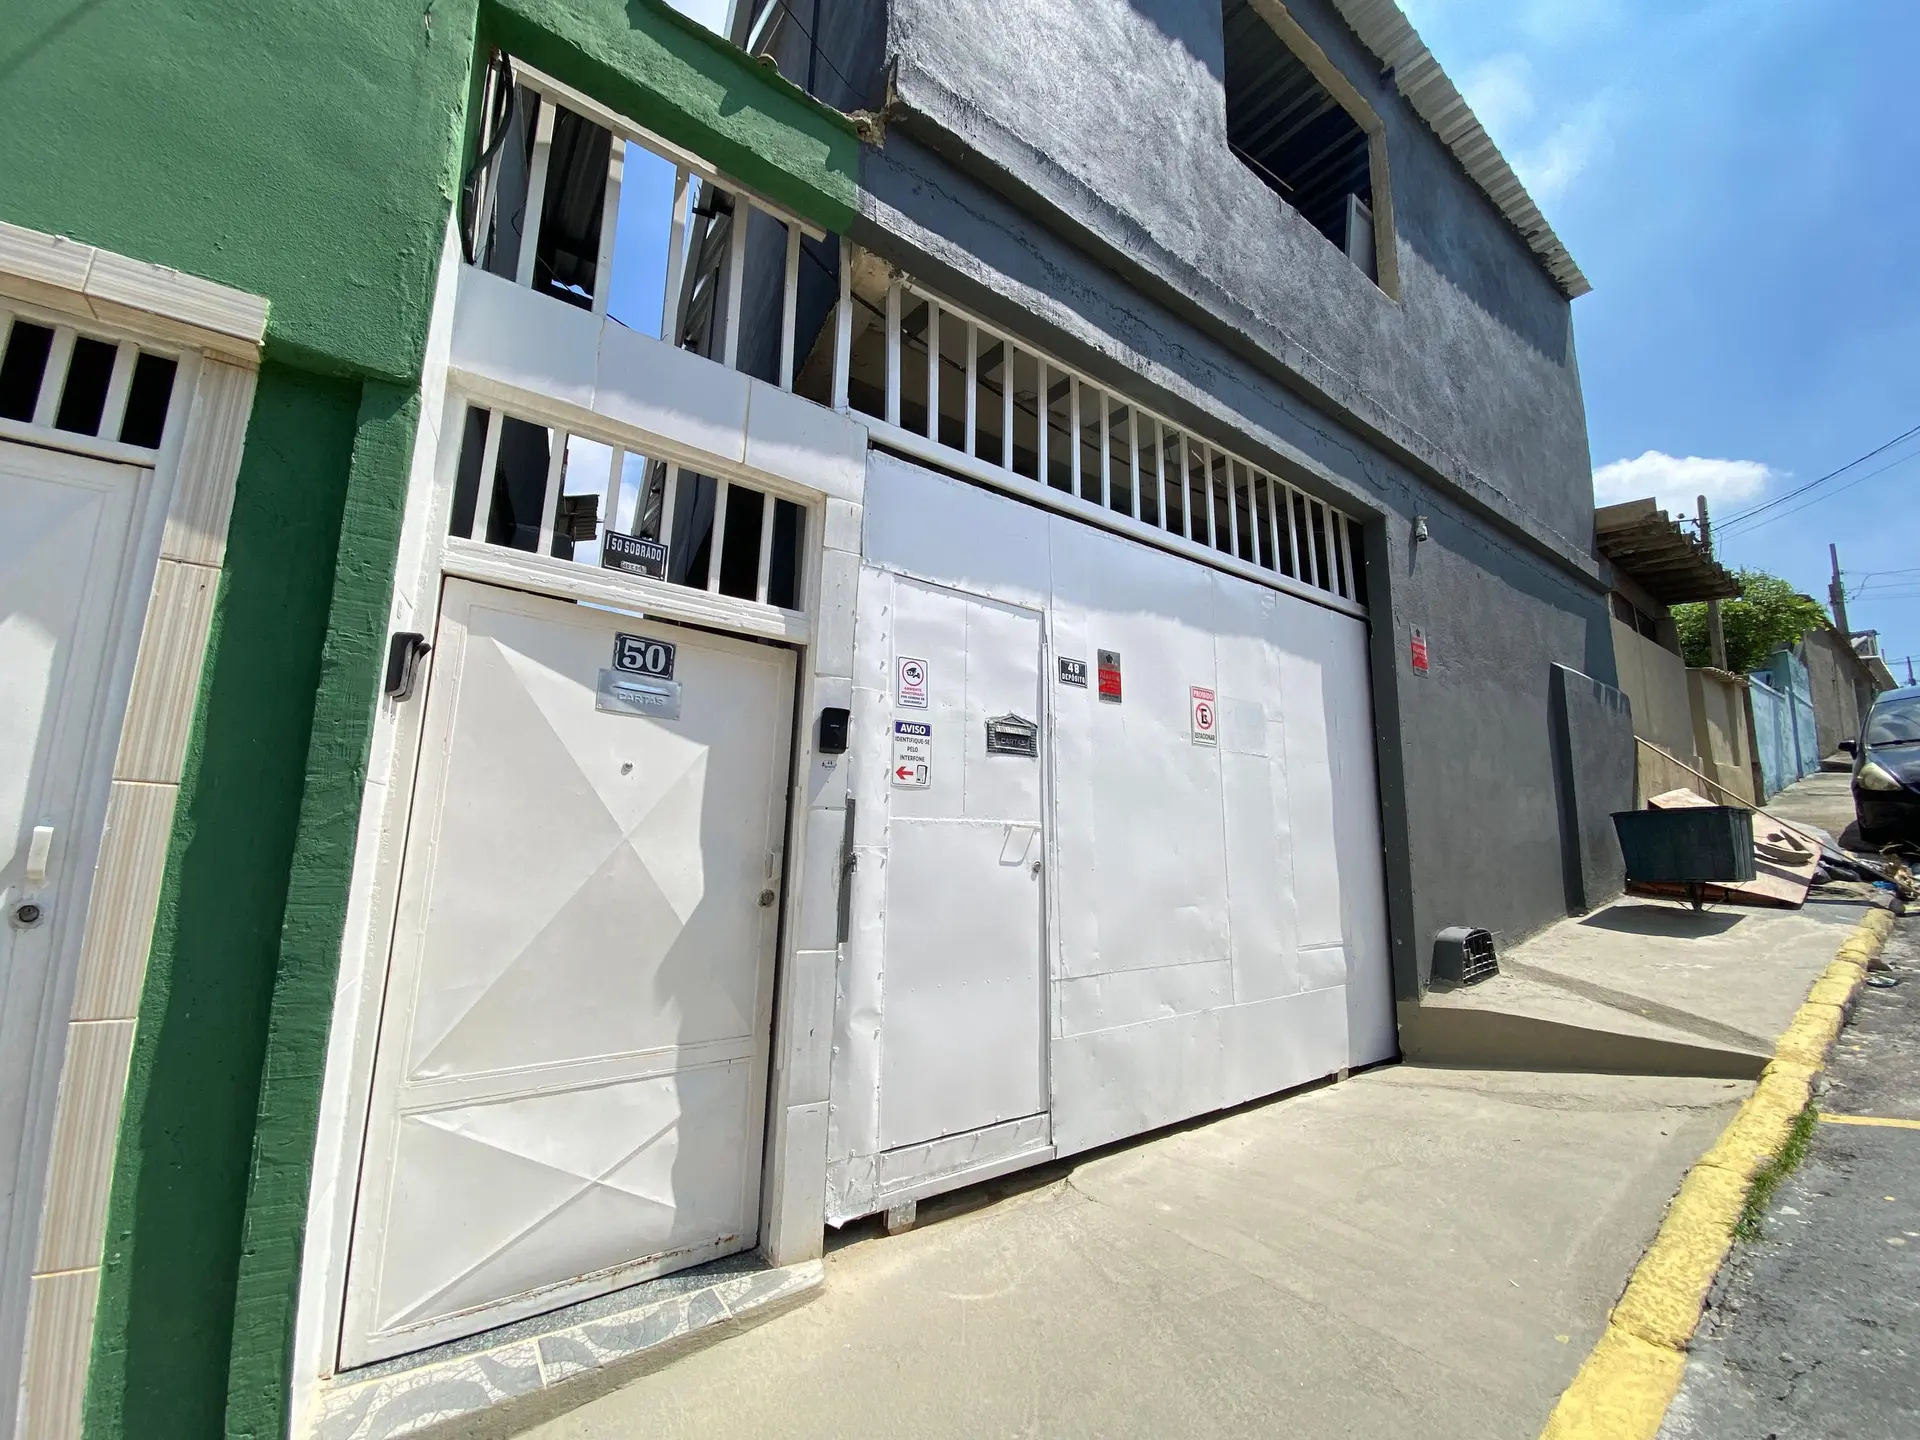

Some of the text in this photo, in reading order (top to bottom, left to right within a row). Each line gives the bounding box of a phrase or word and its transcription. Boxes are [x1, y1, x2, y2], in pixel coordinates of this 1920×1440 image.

[611, 537, 661, 561] 50 SOBRADO
[622, 639, 666, 673] 50
[1068, 662, 1080, 674] 48
[618, 692, 664, 706] CARTAS
[1194, 690, 1213, 699] PROIBIDO
[901, 724, 926, 735] AVISO
[895, 736, 930, 745] IDENTIFIQUE-SE
[1195, 732, 1215, 740] ESTACIONAR
[900, 754, 925, 763] INTERFONE
